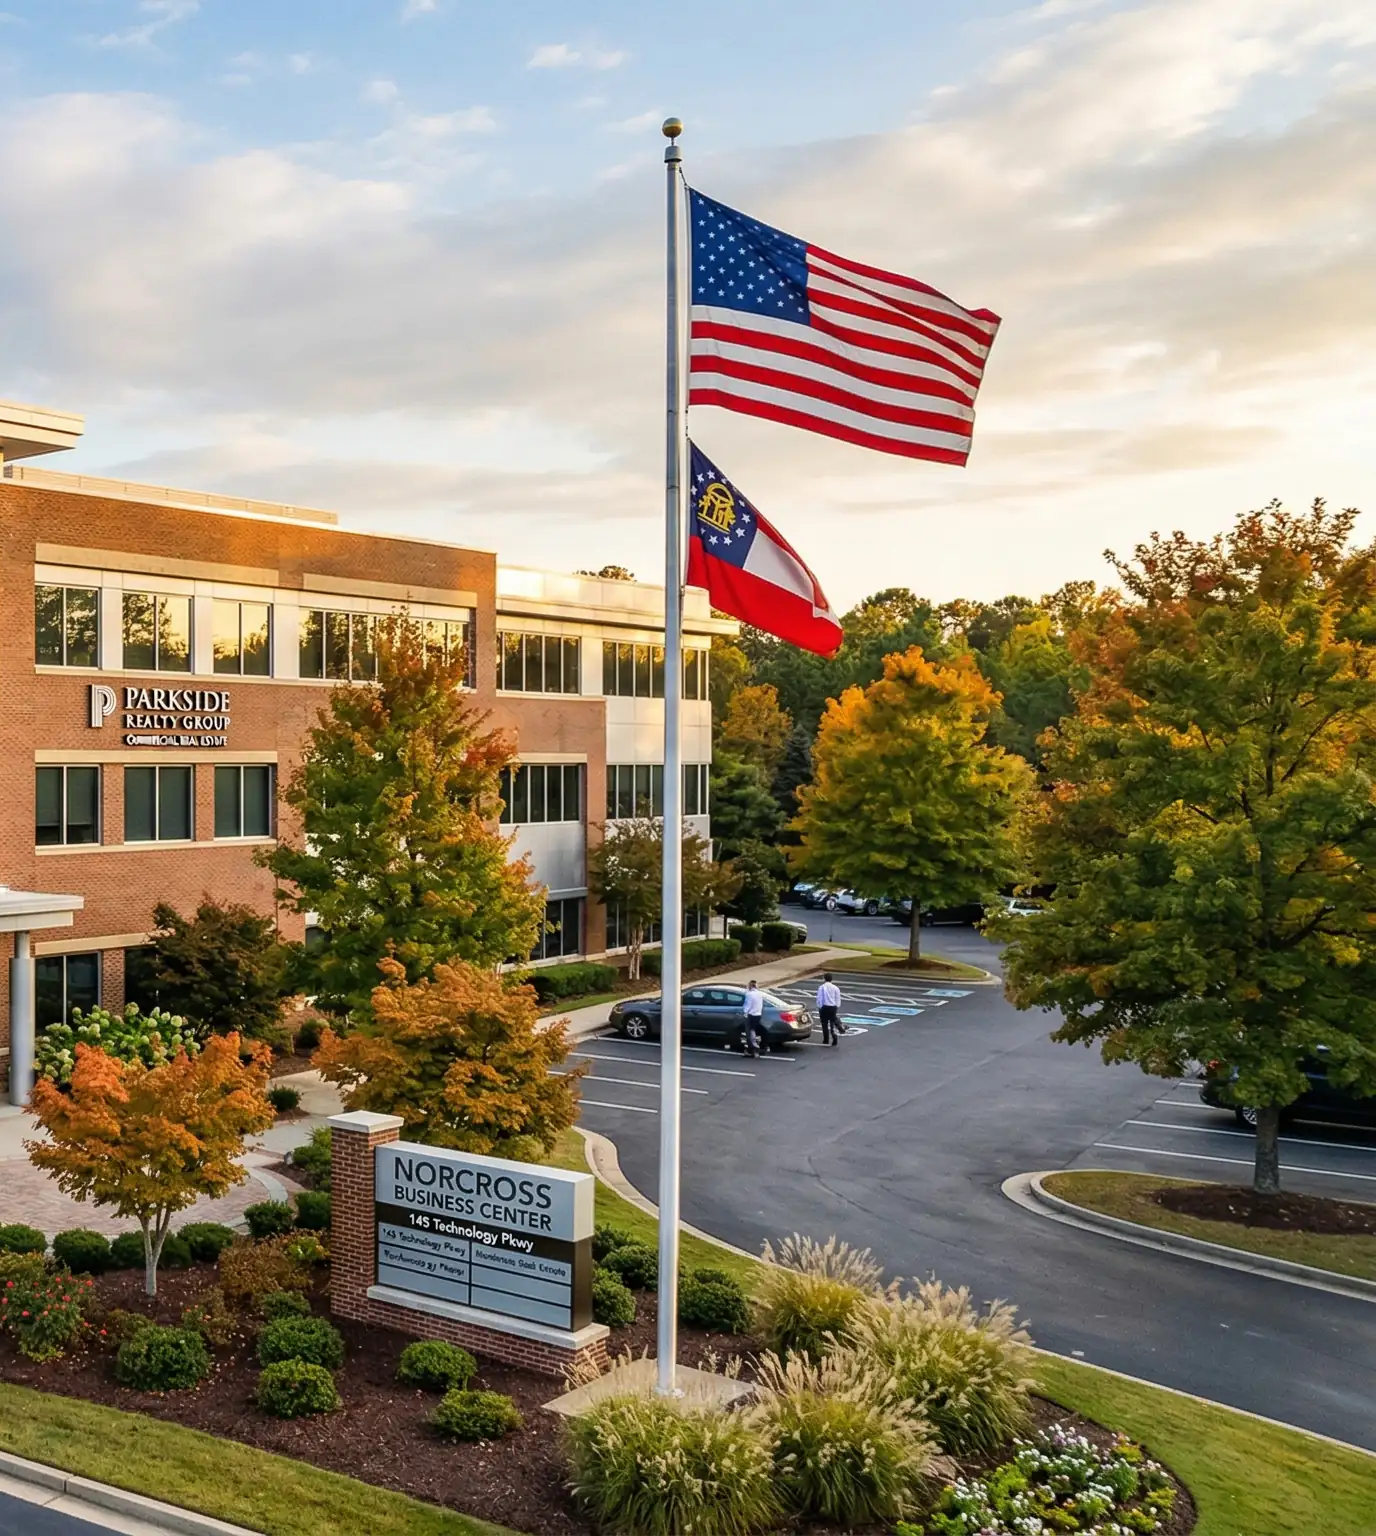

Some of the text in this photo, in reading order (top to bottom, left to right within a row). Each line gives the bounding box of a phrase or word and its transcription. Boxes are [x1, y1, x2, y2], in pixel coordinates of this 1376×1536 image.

[125, 687, 230, 712] PARKSIDE
[126, 715, 230, 730] REALTY GROUP
[394, 1157, 551, 1209] NORCROSS
[394, 1185, 551, 1231] BUSINESS CENTER
[433, 1219, 498, 1244] Technology
[502, 1233, 533, 1253] Pkwy
